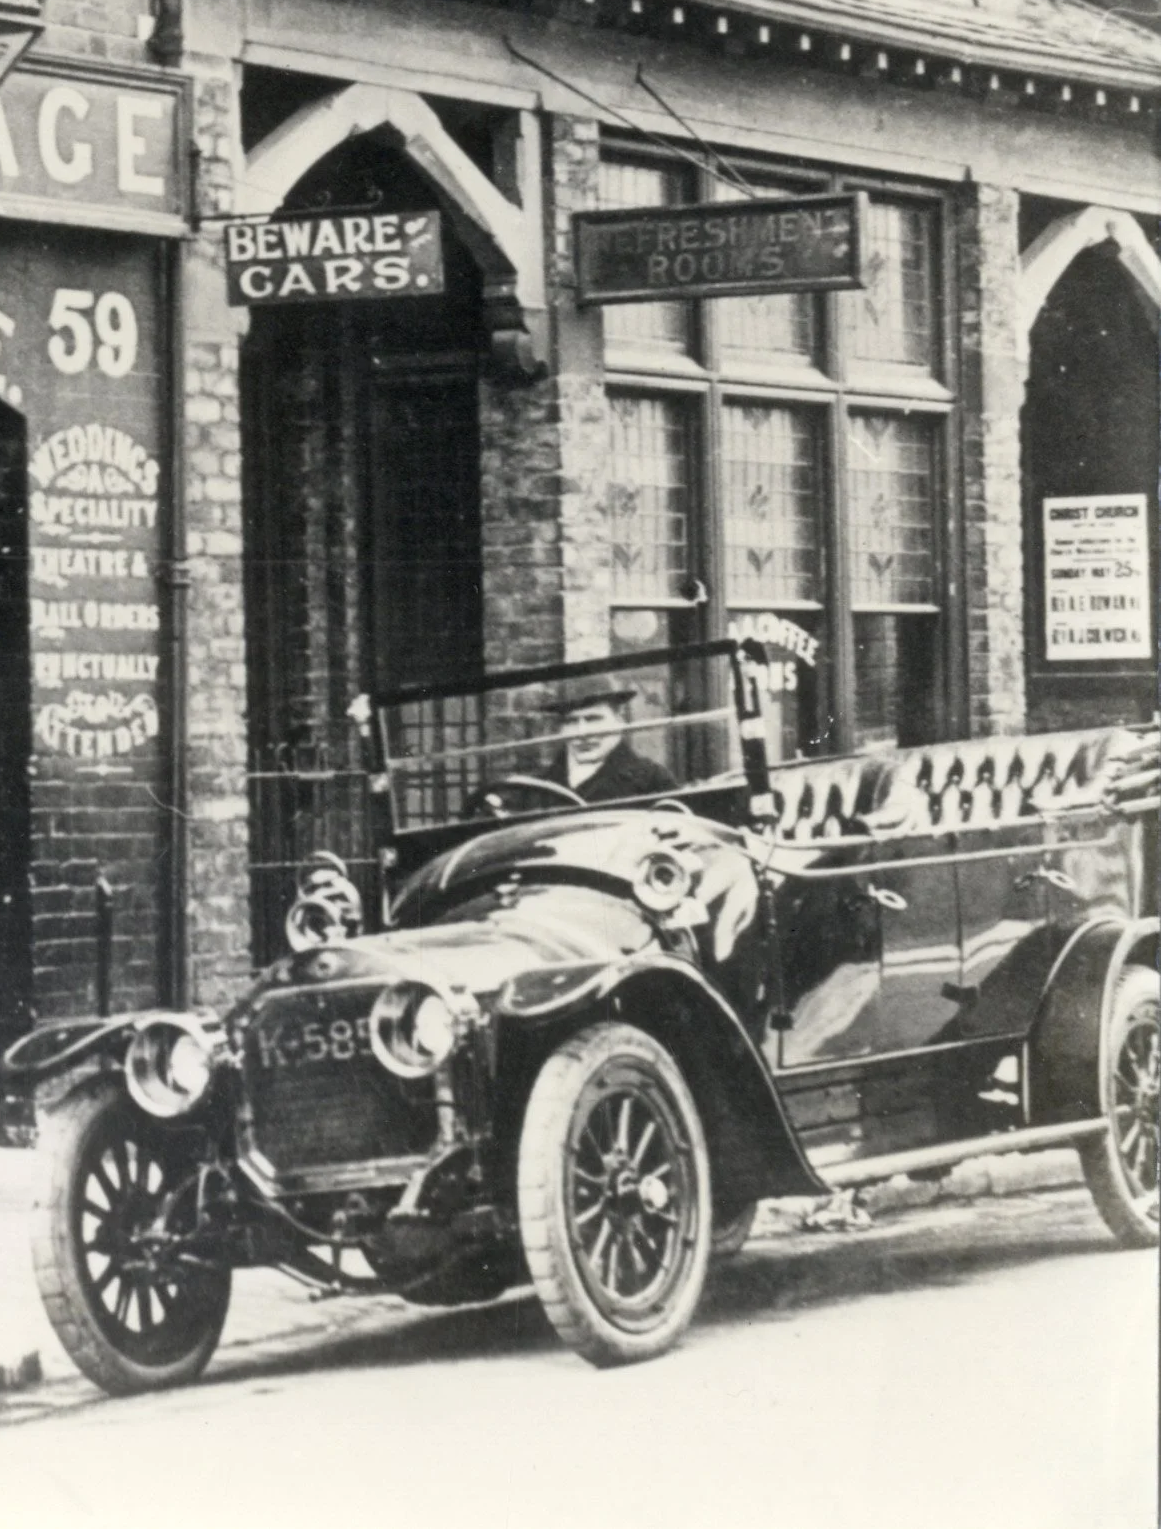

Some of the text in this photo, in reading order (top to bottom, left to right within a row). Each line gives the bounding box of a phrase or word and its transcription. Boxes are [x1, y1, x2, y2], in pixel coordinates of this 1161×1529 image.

[228, 214, 403, 262] BEWARE
[239, 257, 430, 299] CARS.
[647, 245, 785, 285] ROOMS
[47, 288, 138, 379] 59
[27, 422, 161, 497] WEDDINGS
[29, 489, 159, 530] SPECIALITY
